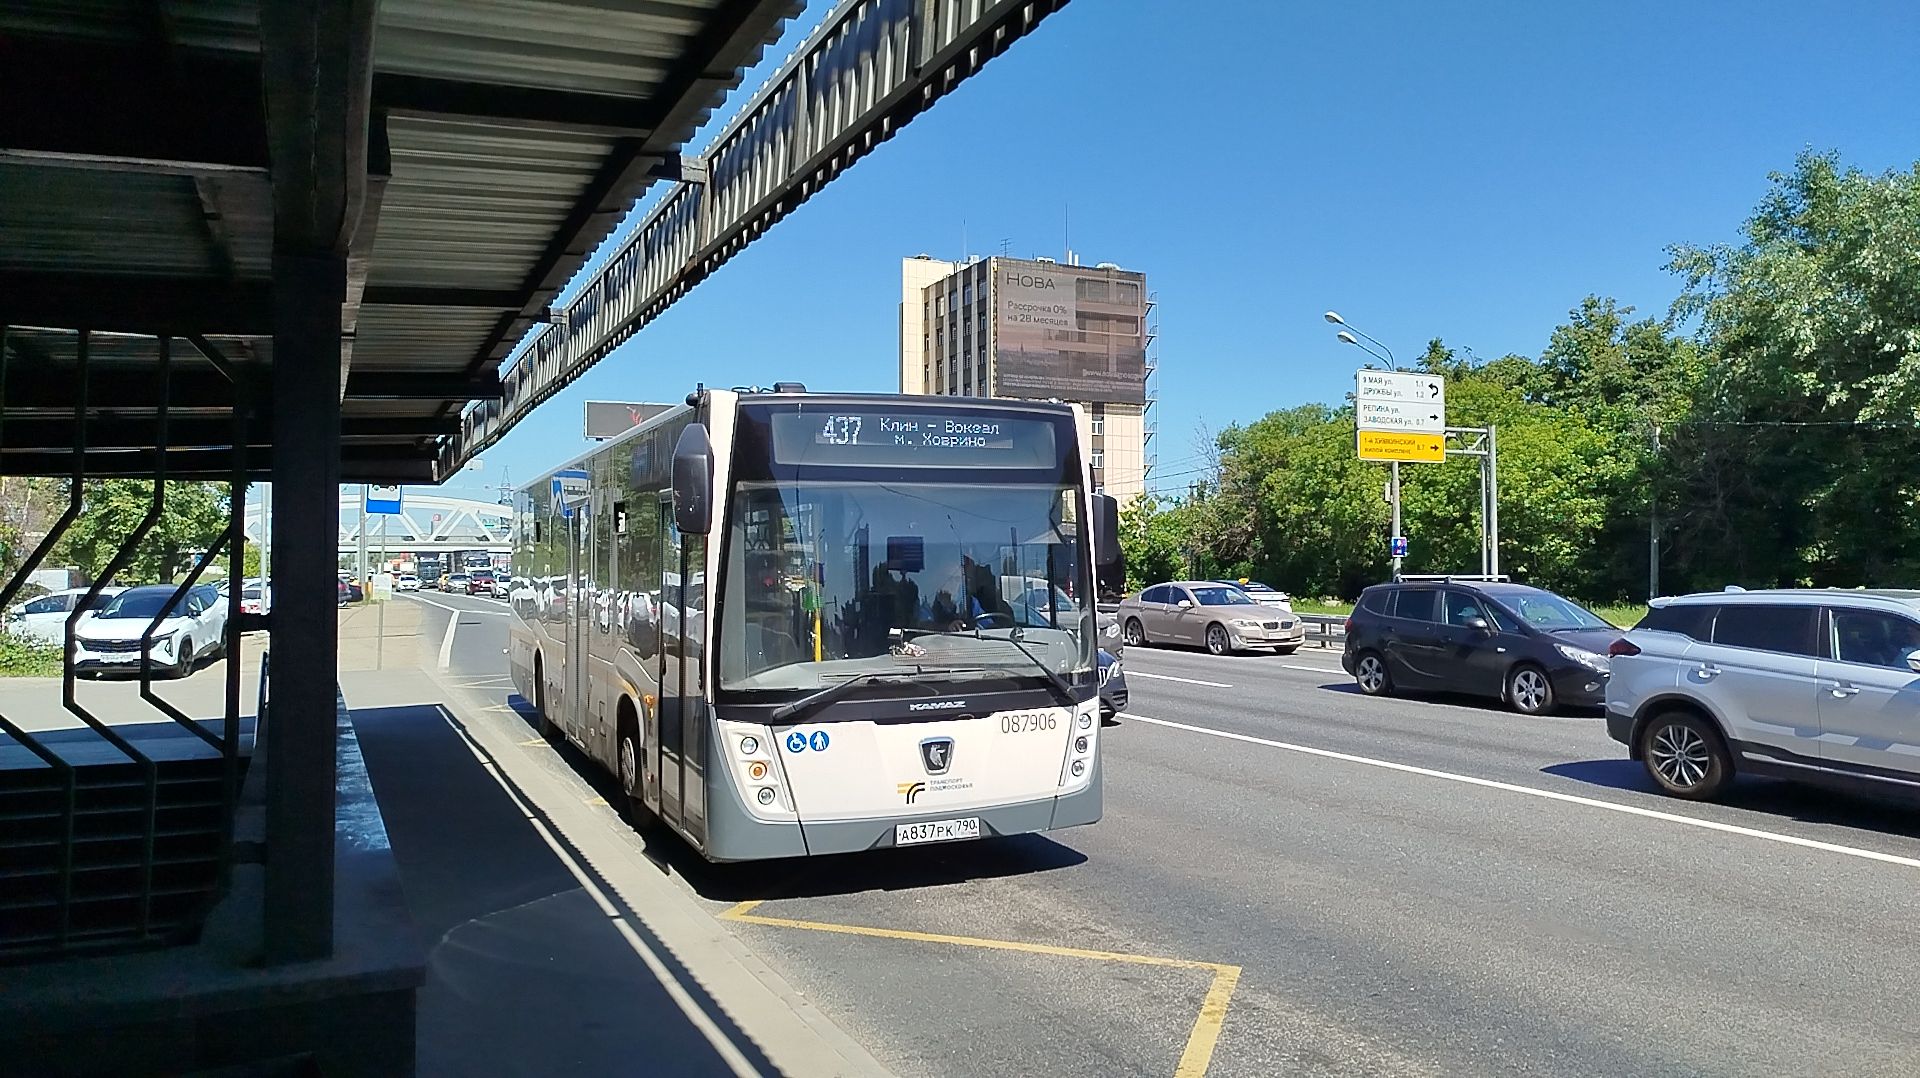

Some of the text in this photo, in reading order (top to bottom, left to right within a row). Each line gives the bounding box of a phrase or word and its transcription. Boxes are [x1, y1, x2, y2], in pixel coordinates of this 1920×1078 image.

[1006, 272, 1055, 290] НОВА
[1007, 300, 1067, 314] Рассрочка 0%
[1019, 314, 1031, 322] 28
[1033, 316, 1069, 327] месяцев
[1368, 376, 1383, 384] МАЯ
[1363, 387, 1392, 396] ДРУЖБЫ
[1363, 404, 1390, 413] РЕПИНА
[879, 417, 919, 432] Клин
[945, 420, 1000, 435] Вокзал
[1363, 415, 1403, 424] ЗАВОДСКАЯ
[822, 415, 862, 445] 437
[894, 432, 987, 448] м. Ховрино
[909, 700, 966, 711] KAMAZ
[1001, 712, 1057, 733] 087906
